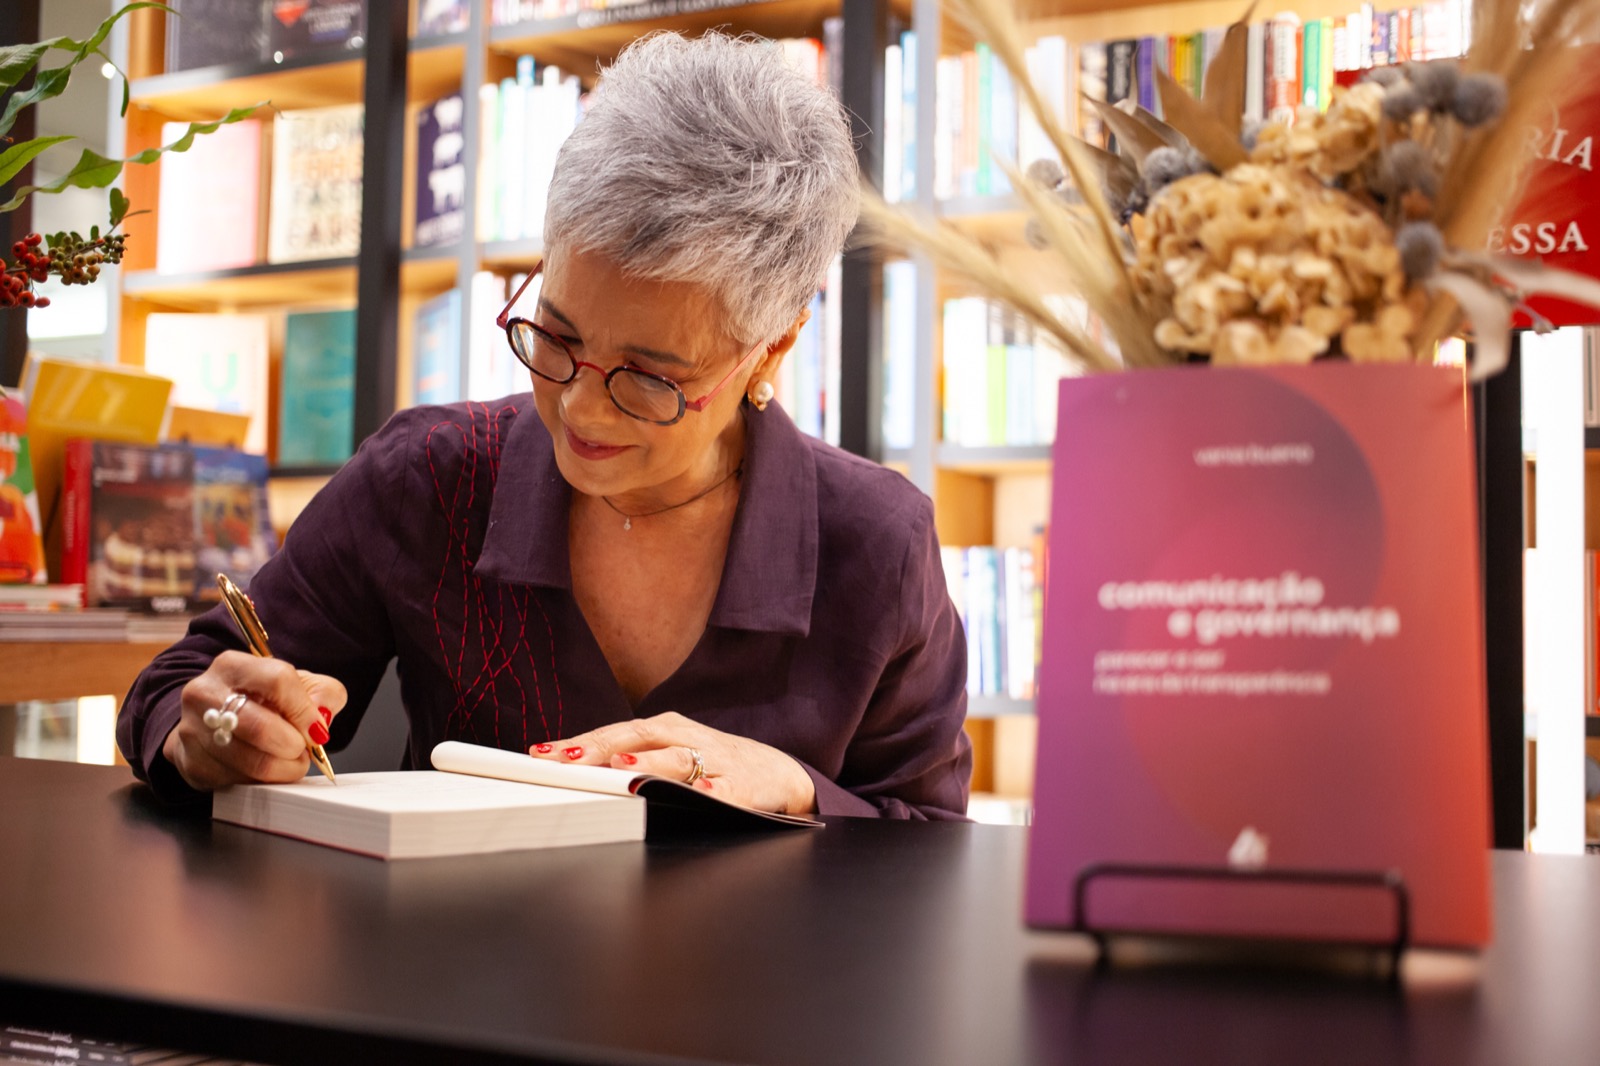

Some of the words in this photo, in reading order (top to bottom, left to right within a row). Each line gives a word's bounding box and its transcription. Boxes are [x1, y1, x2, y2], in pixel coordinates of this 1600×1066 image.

[1097, 570, 1324, 610] comunicação
[1167, 609, 1192, 637] e
[1196, 605, 1400, 645] governança
